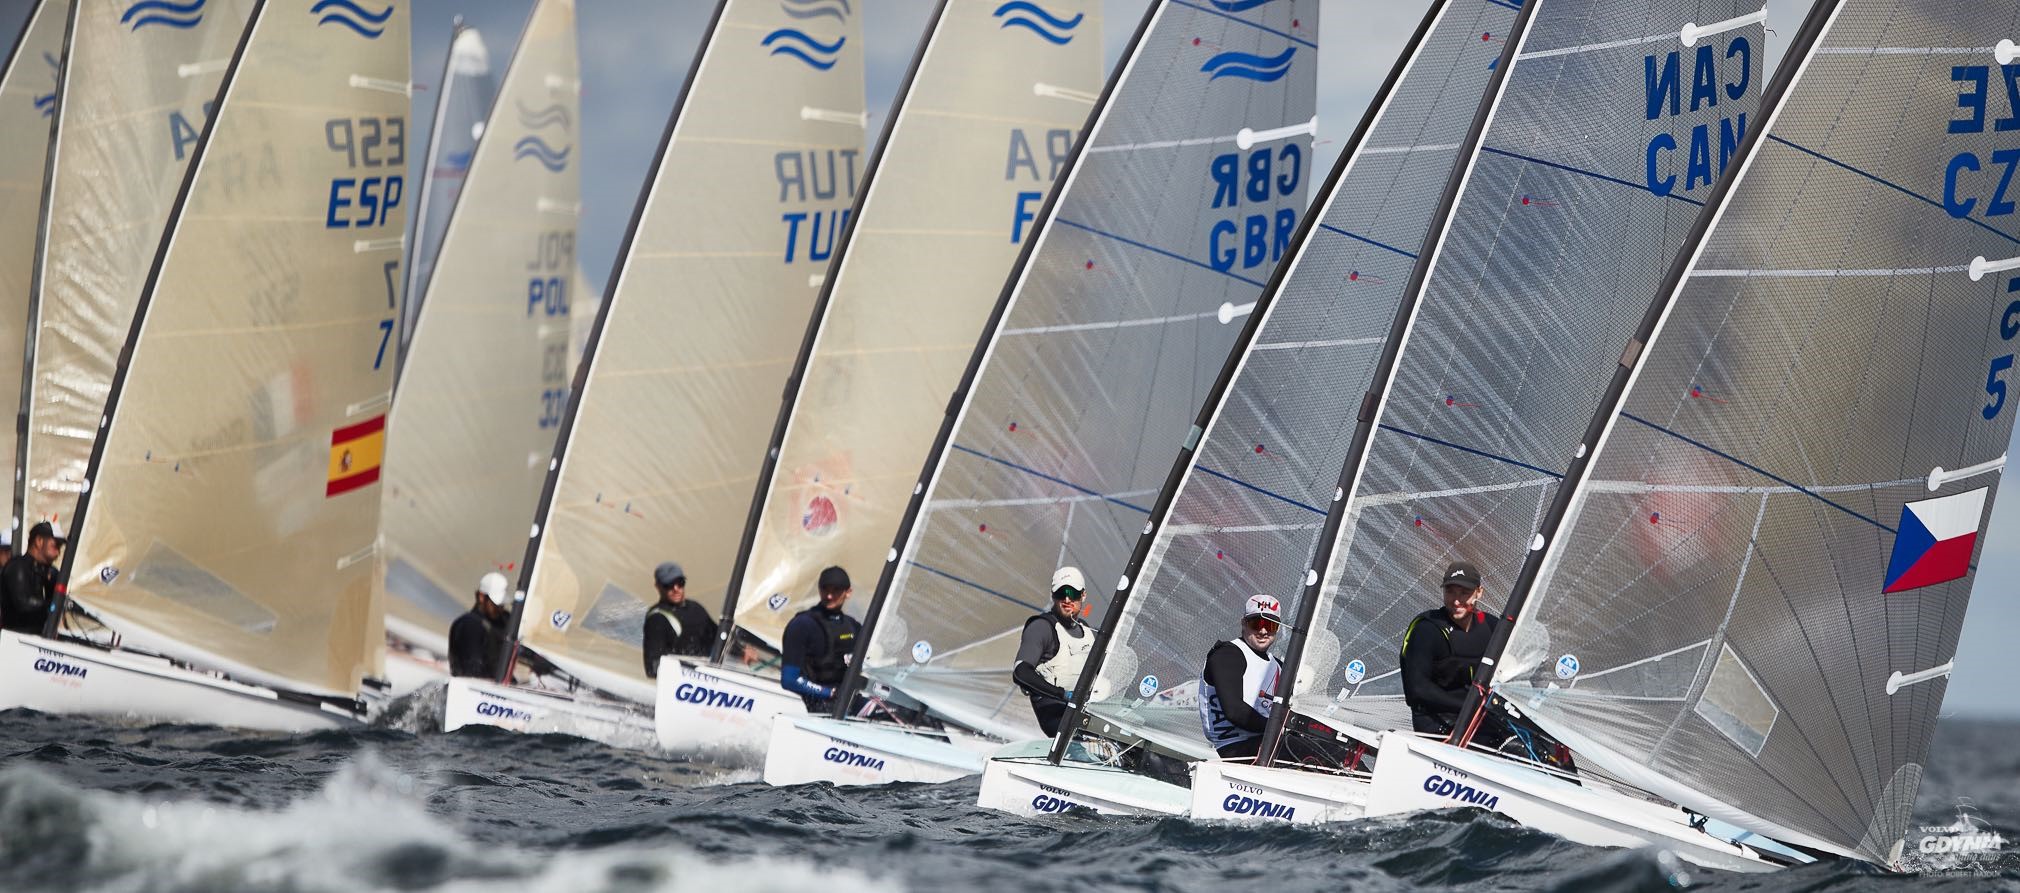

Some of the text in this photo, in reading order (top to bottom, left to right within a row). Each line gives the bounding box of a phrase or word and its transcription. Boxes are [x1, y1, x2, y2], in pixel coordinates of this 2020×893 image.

[1943, 147, 2020, 219] CZ
[326, 176, 403, 229] ESP
[1209, 208, 1295, 273] GBR
[528, 277, 570, 319] POL
[374, 319, 394, 370] 7
[1982, 353, 2014, 421] 5
[34, 658, 87, 679] GDYNIA
[675, 683, 755, 712] GDYNIA
[823, 747, 885, 771] GDYNIA
[1031, 794, 1098, 814] GDY
[1040, 784, 1071, 797] VOLVO
[1229, 782, 1263, 795] VOLVO
[1423, 774, 1499, 811] GDYNIA
[1222, 793, 1296, 821] GDYNIA
